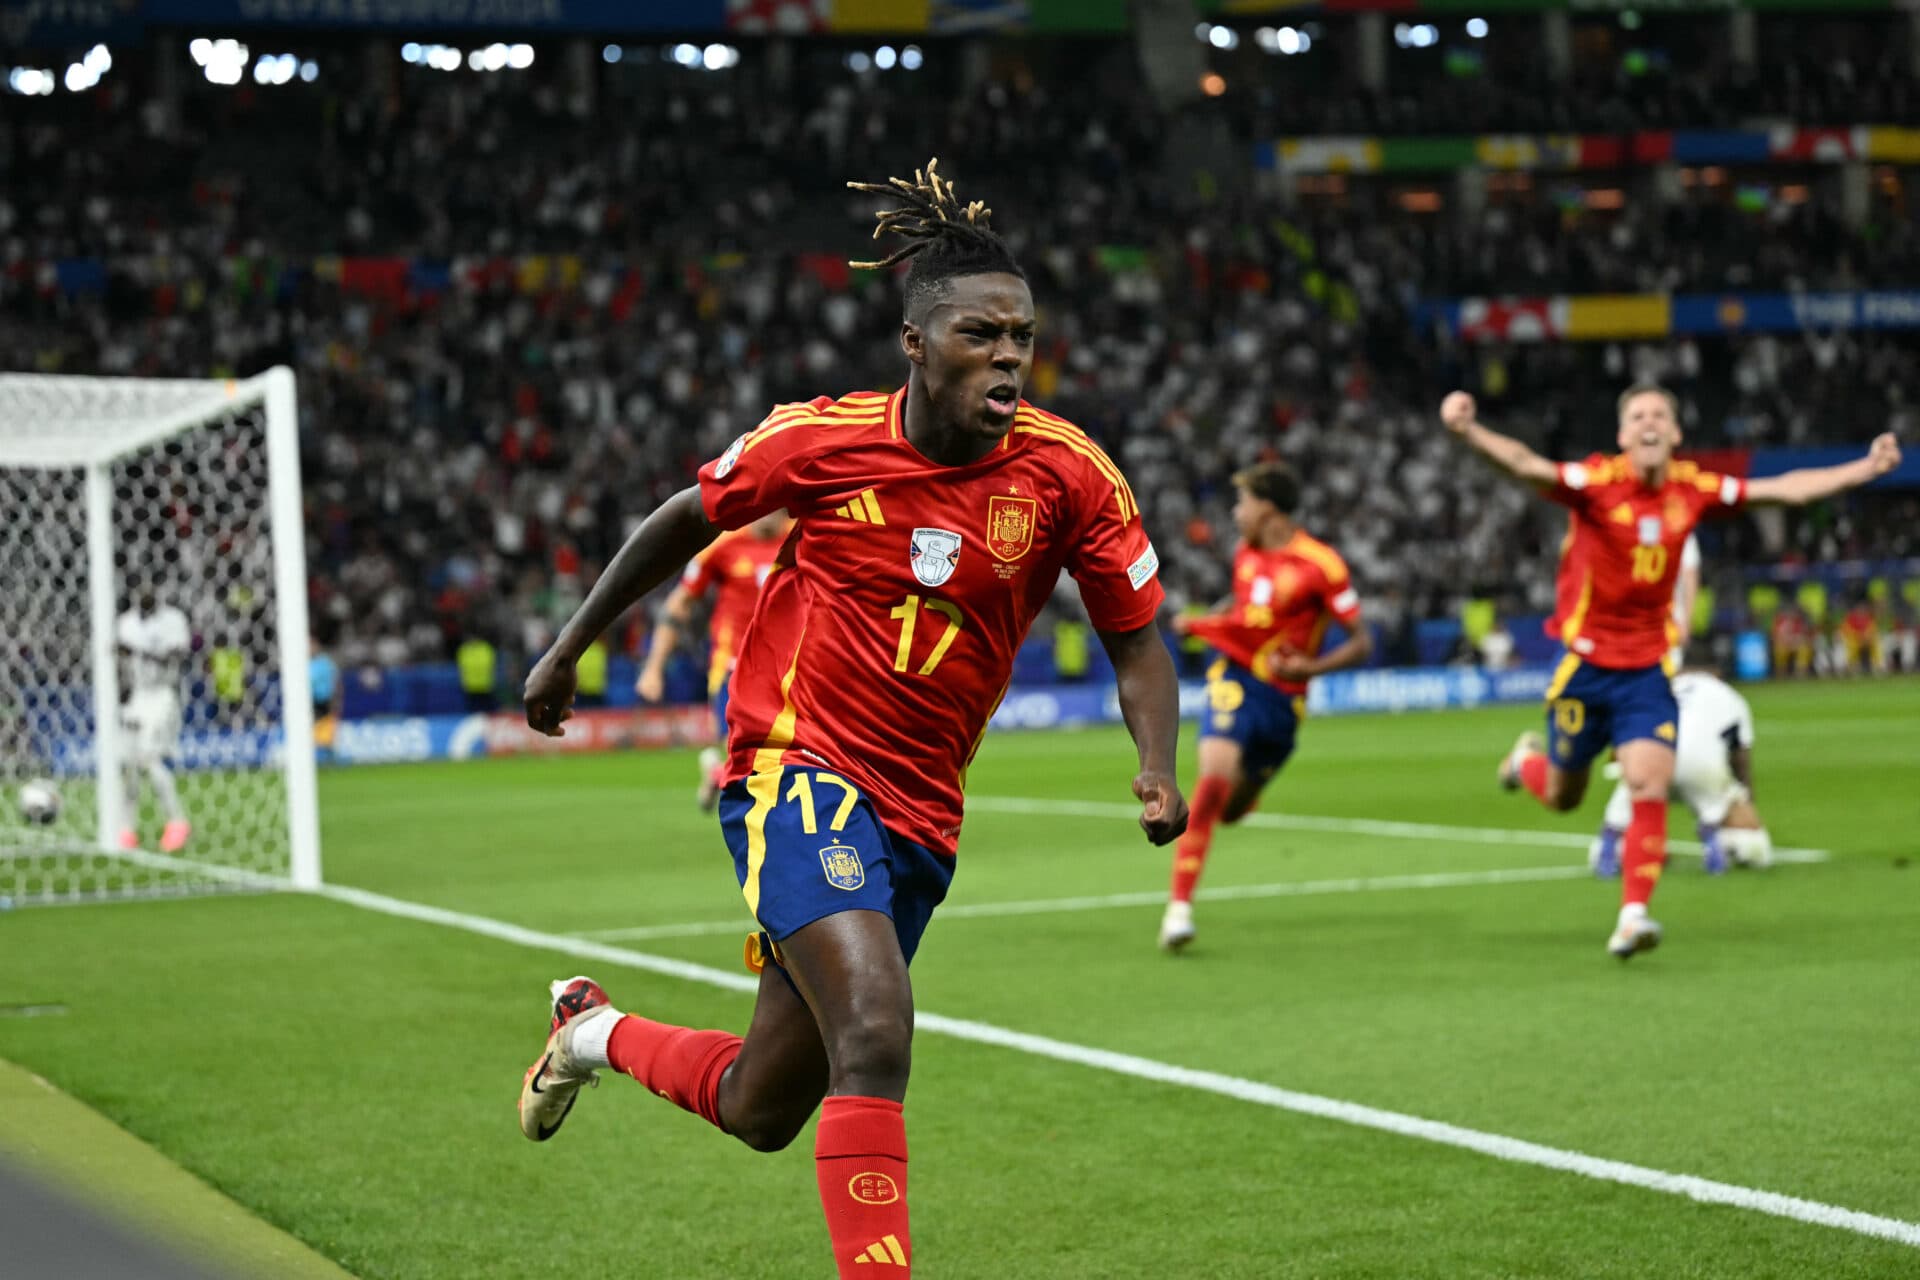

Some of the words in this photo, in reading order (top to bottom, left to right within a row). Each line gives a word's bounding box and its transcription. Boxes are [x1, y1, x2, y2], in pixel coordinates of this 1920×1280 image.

[1631, 545, 1667, 583] 10
[890, 594, 963, 676] 17
[786, 772, 859, 834] 17
